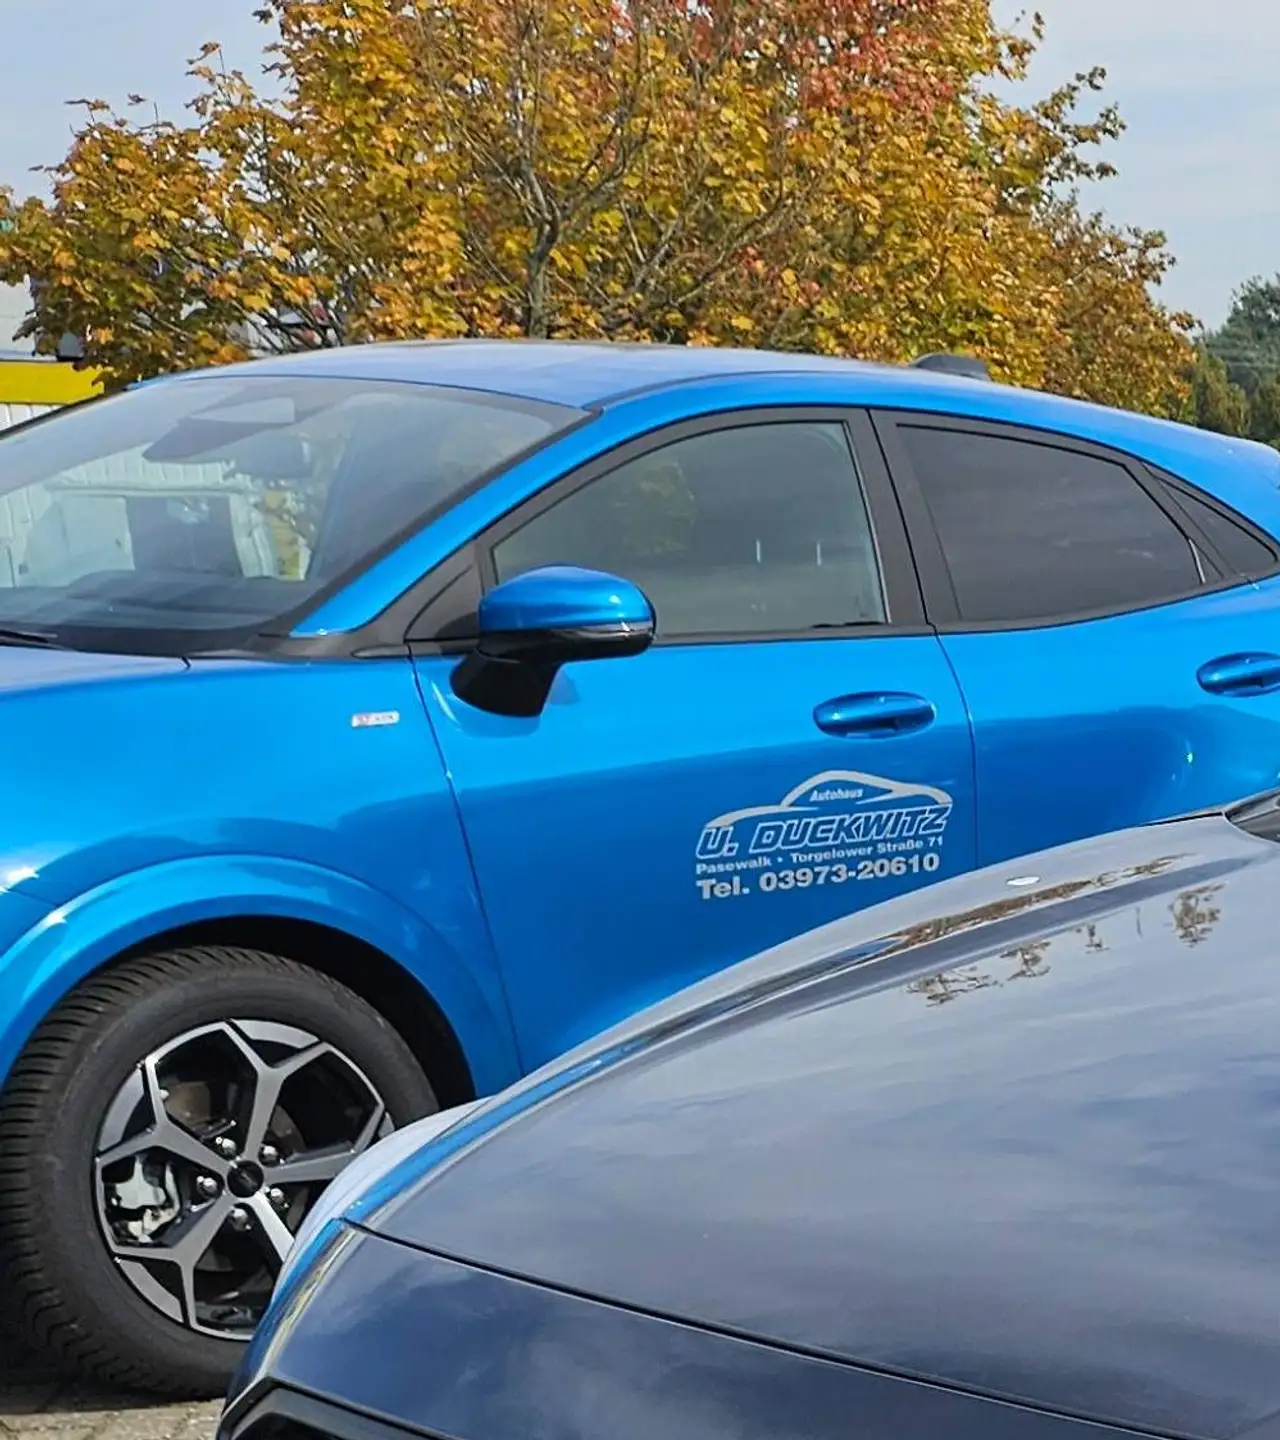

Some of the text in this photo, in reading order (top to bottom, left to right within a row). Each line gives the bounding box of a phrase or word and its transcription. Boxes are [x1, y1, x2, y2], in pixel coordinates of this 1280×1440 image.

[809, 787, 863, 802] Autohaus
[696, 804, 953, 860] U. DUCKWITZ
[696, 836, 944, 875] Pasewalk Torgelower Straße 71
[696, 852, 940, 900] Tel. 03973-20610
